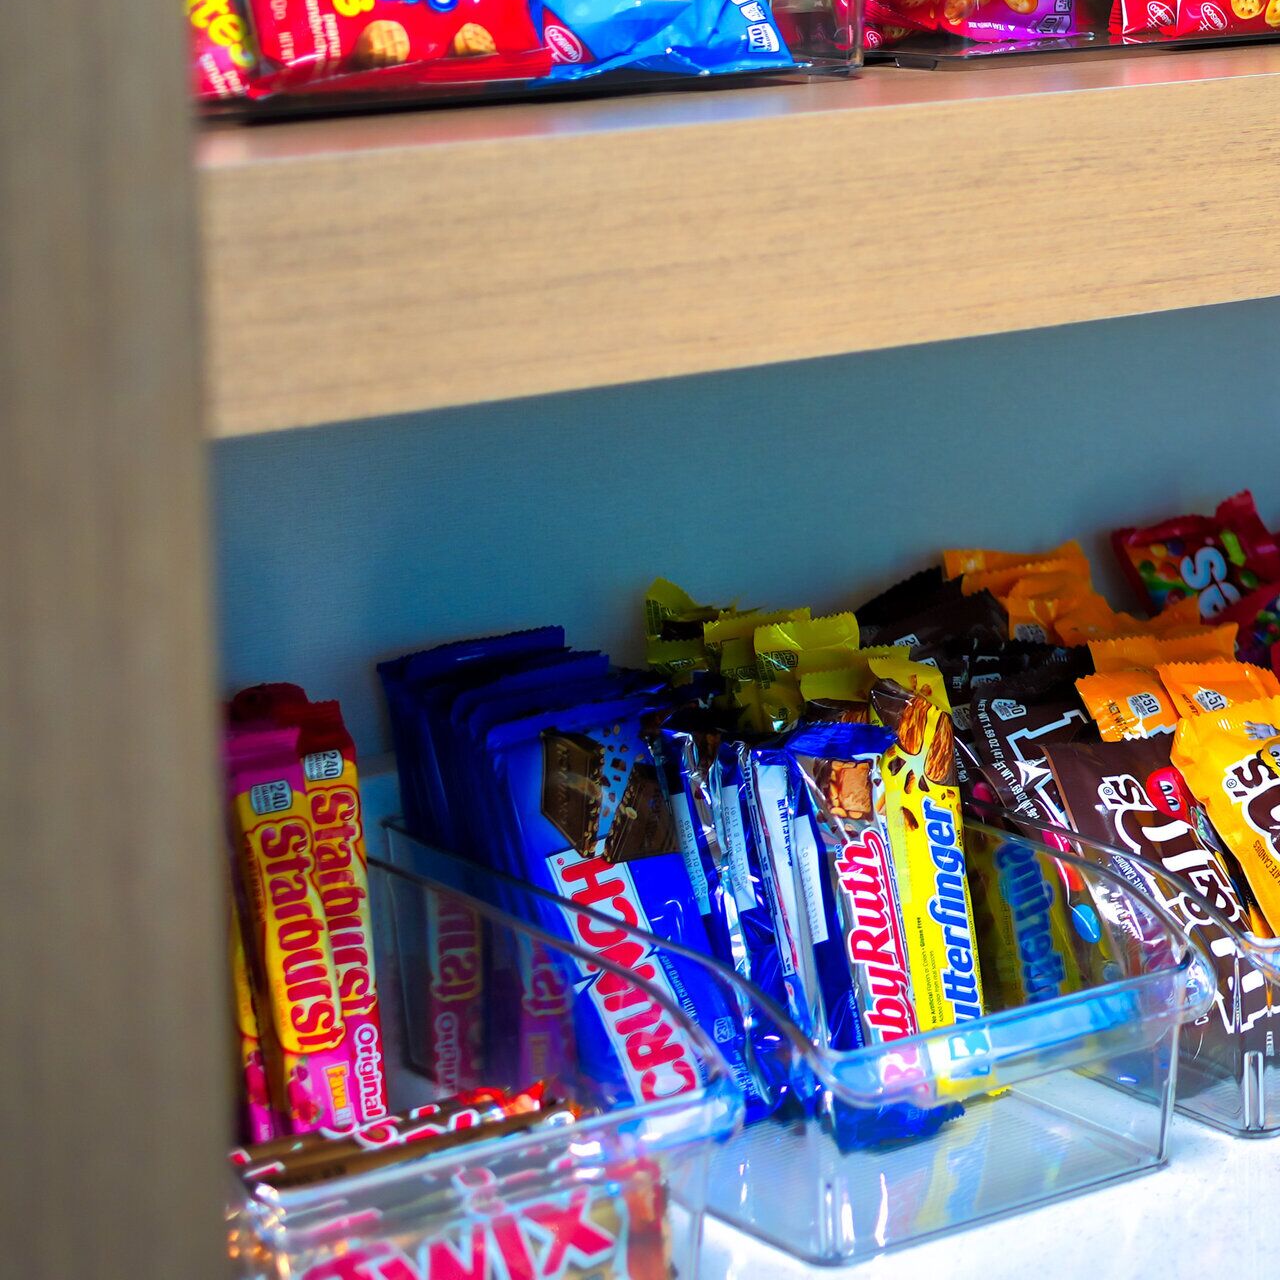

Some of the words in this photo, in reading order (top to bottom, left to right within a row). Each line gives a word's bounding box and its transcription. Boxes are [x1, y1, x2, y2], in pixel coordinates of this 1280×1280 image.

[750, 26, 764, 50] 140
[1138, 692, 1160, 713] 250
[321, 751, 340, 779] 240
[270, 781, 288, 810] 240
[1252, 839, 1275, 869] CANDIES
[310, 791, 377, 1017] Starburst
[259, 821, 345, 1048] Starburst
[562, 857, 698, 1102] CRUNCH
[354, 1023, 383, 1119] Original
